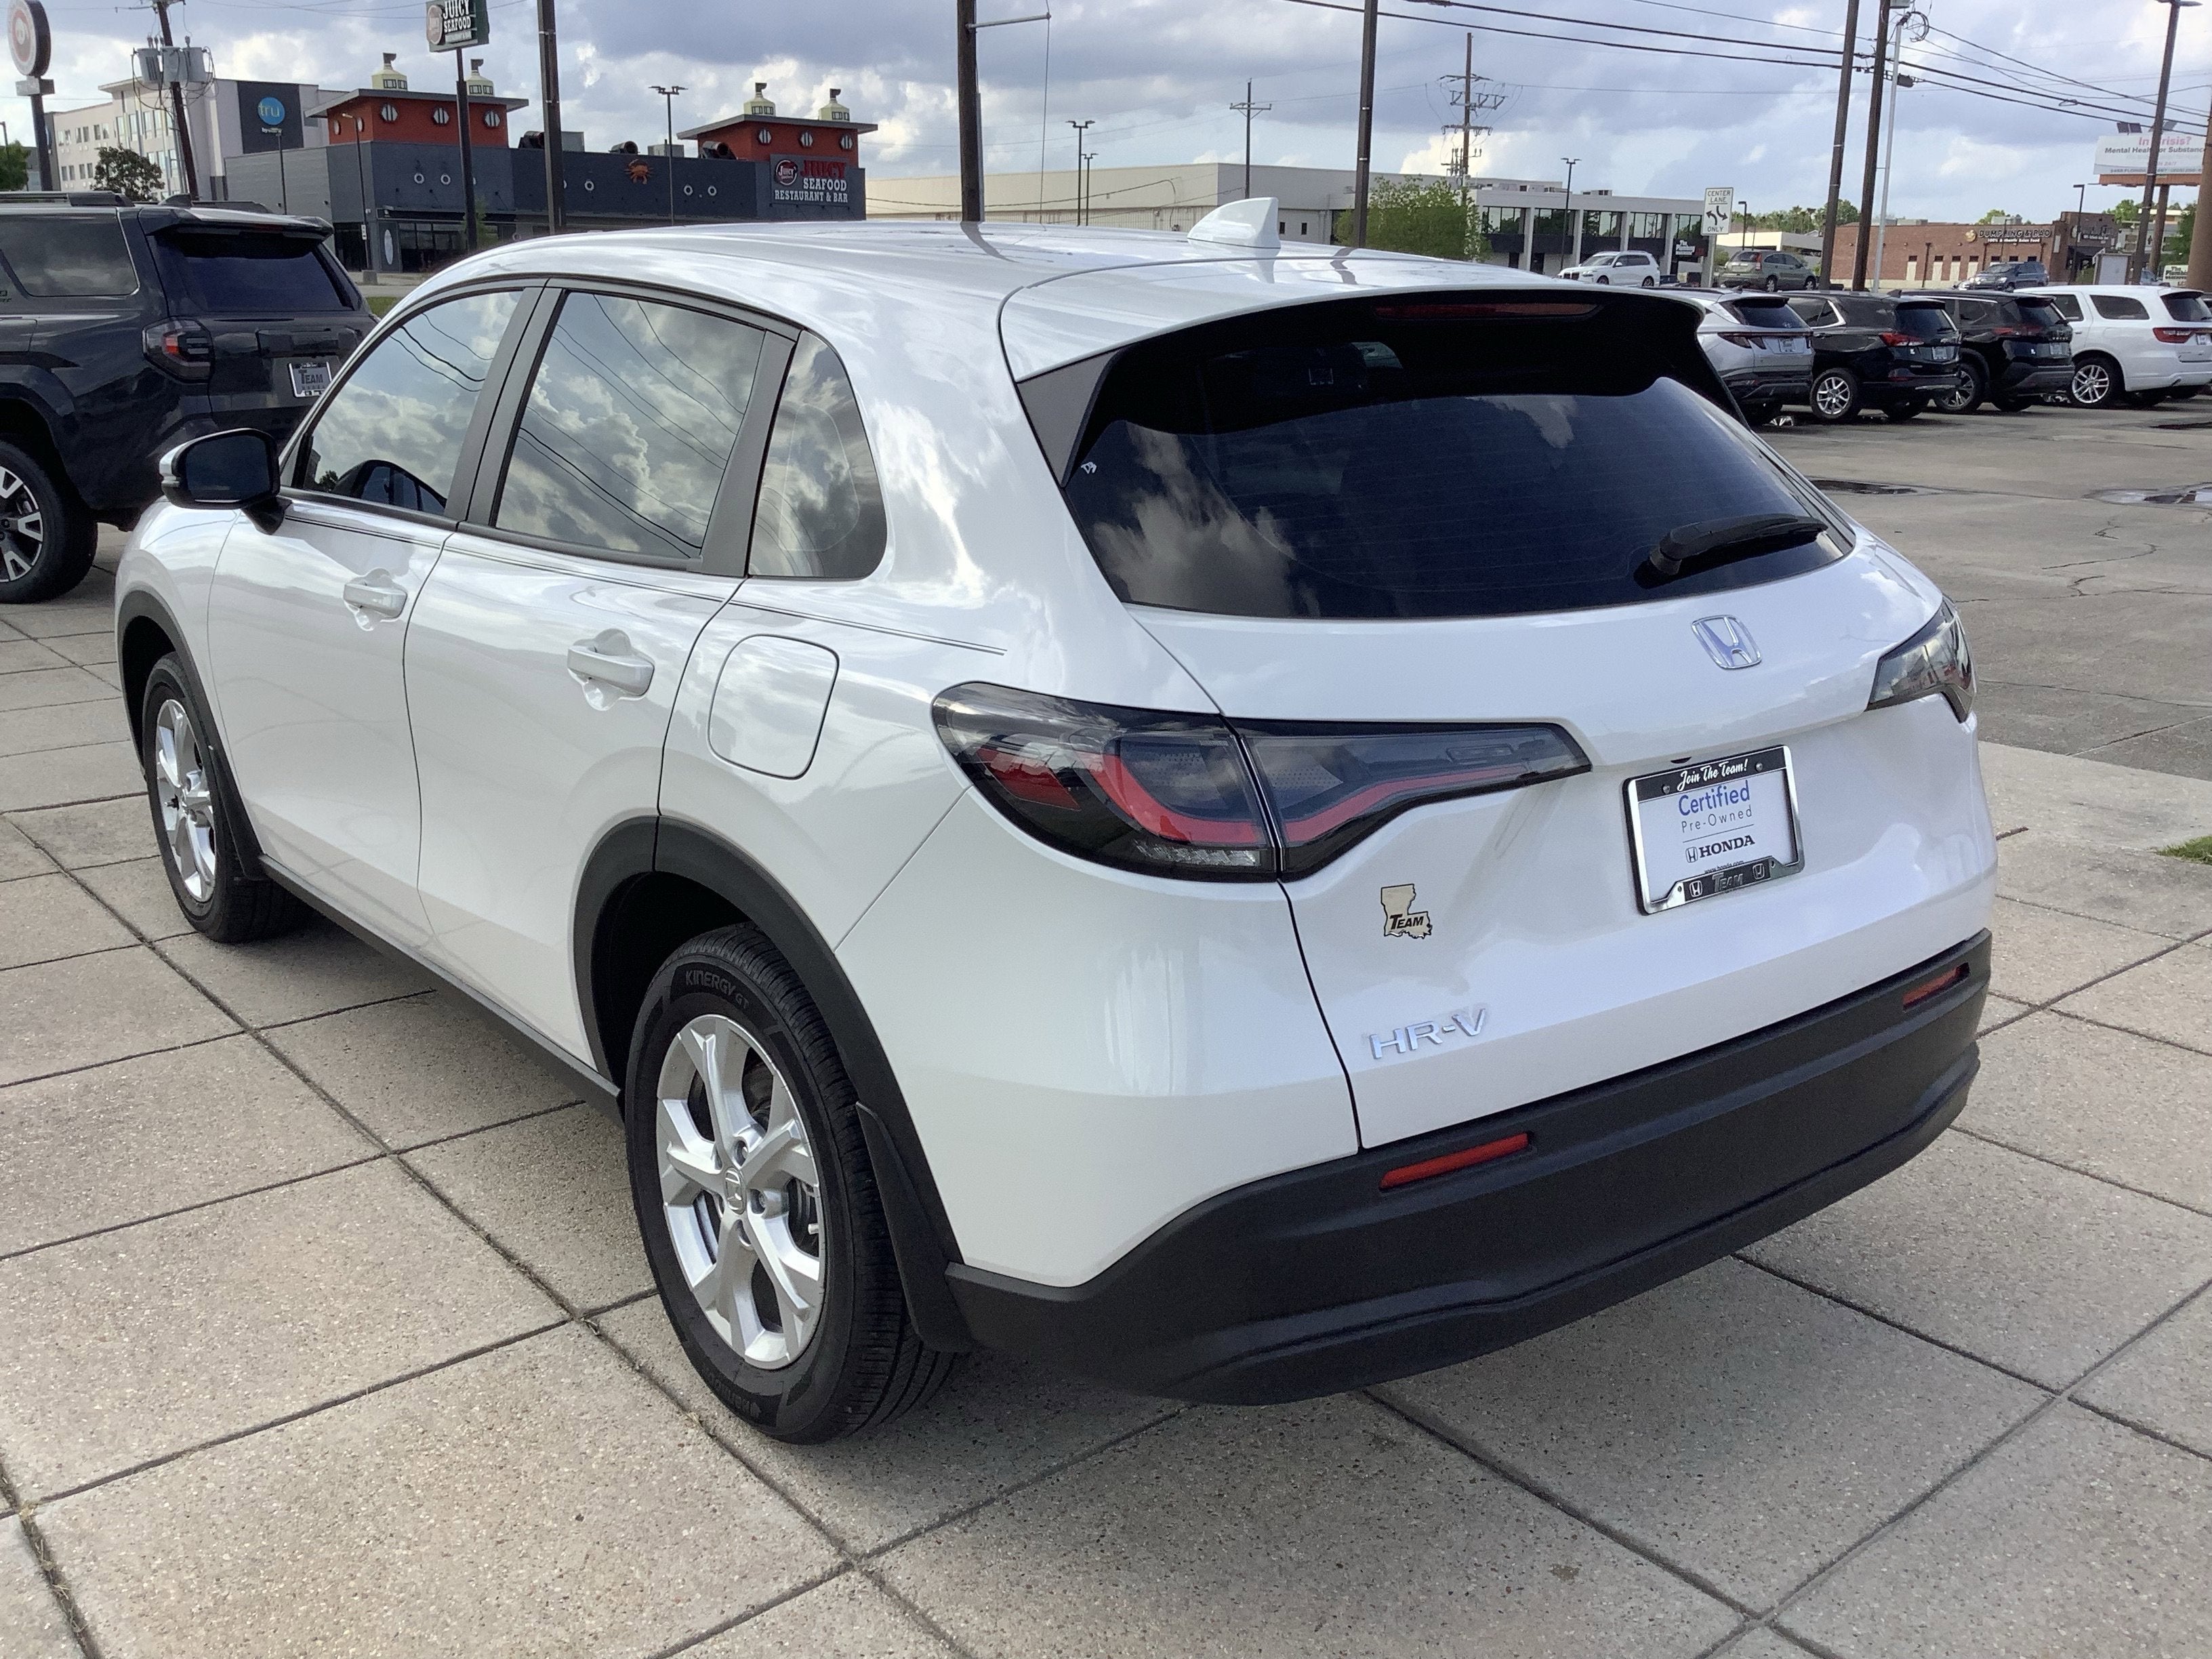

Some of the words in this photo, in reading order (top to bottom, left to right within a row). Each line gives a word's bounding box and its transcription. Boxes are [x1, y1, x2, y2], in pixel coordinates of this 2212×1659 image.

[443, 0, 470, 19] JUICY
[444, 16, 471, 33] SEAFOOD
[258, 102, 280, 117] tru
[2139, 137, 2149, 146] In
[2161, 136, 2192, 146] risis?
[800, 160, 846, 180] JUICY
[803, 178, 847, 191] SEAFOOD
[775, 190, 824, 201] RESTAURANT
[826, 192, 832, 202] &
[833, 192, 848, 203] BAR
[1979, 229, 2023, 237] DUMPING
[2024, 229, 2032, 237] &
[2033, 228, 2051, 237] BAO
[298, 369, 323, 384] TEAM
[1677, 771, 1700, 792] Join
[1700, 764, 1719, 781] The
[1719, 758, 1748, 777] Team!
[1679, 780, 1750, 816] Certified
[1681, 804, 1753, 833] Pre-Owned
[1699, 835, 1755, 858] HONDA
[1712, 872, 1744, 893] TEAM
[1389, 914, 1425, 930] TEAM
[1369, 1008, 1486, 1059] HR-V
